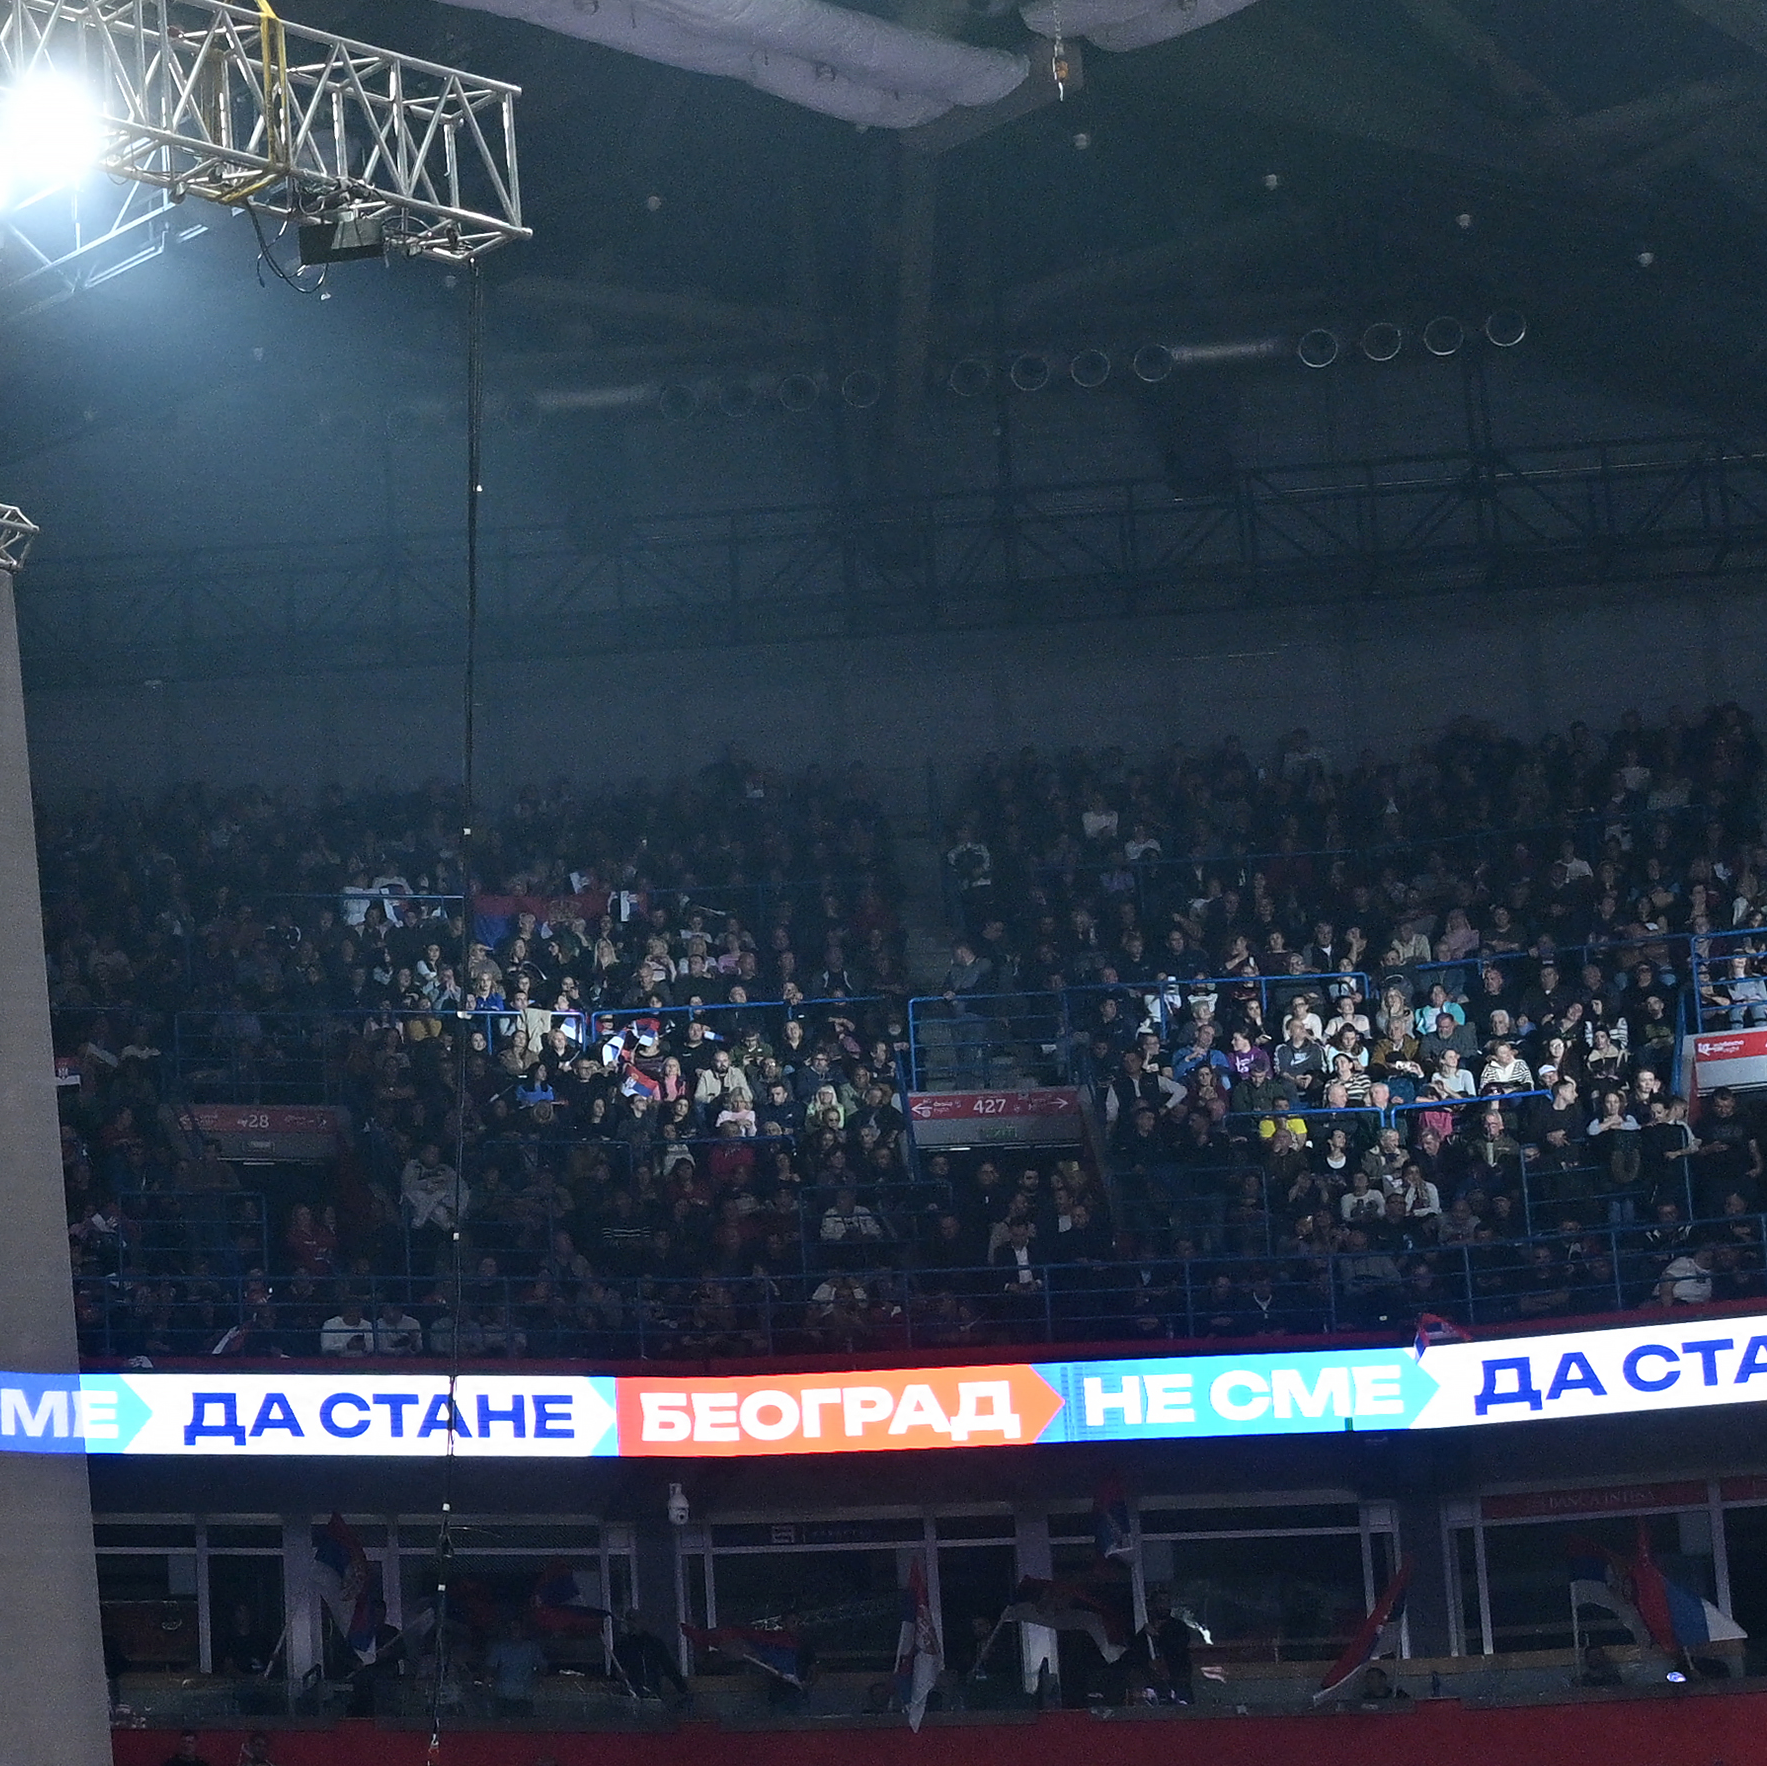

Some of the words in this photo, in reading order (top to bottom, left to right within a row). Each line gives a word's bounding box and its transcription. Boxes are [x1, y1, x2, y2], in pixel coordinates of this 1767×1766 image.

[973, 1098, 1006, 1114] 427
[182, 1390, 311, 1446] ДА
[318, 1390, 575, 1439] СТАНЕ
[640, 1380, 1022, 1443] БЕОГРАД
[1085, 1371, 1196, 1426] НЕ
[1209, 1363, 1404, 1421] СМЕ
[1473, 1351, 1608, 1416] ДА
